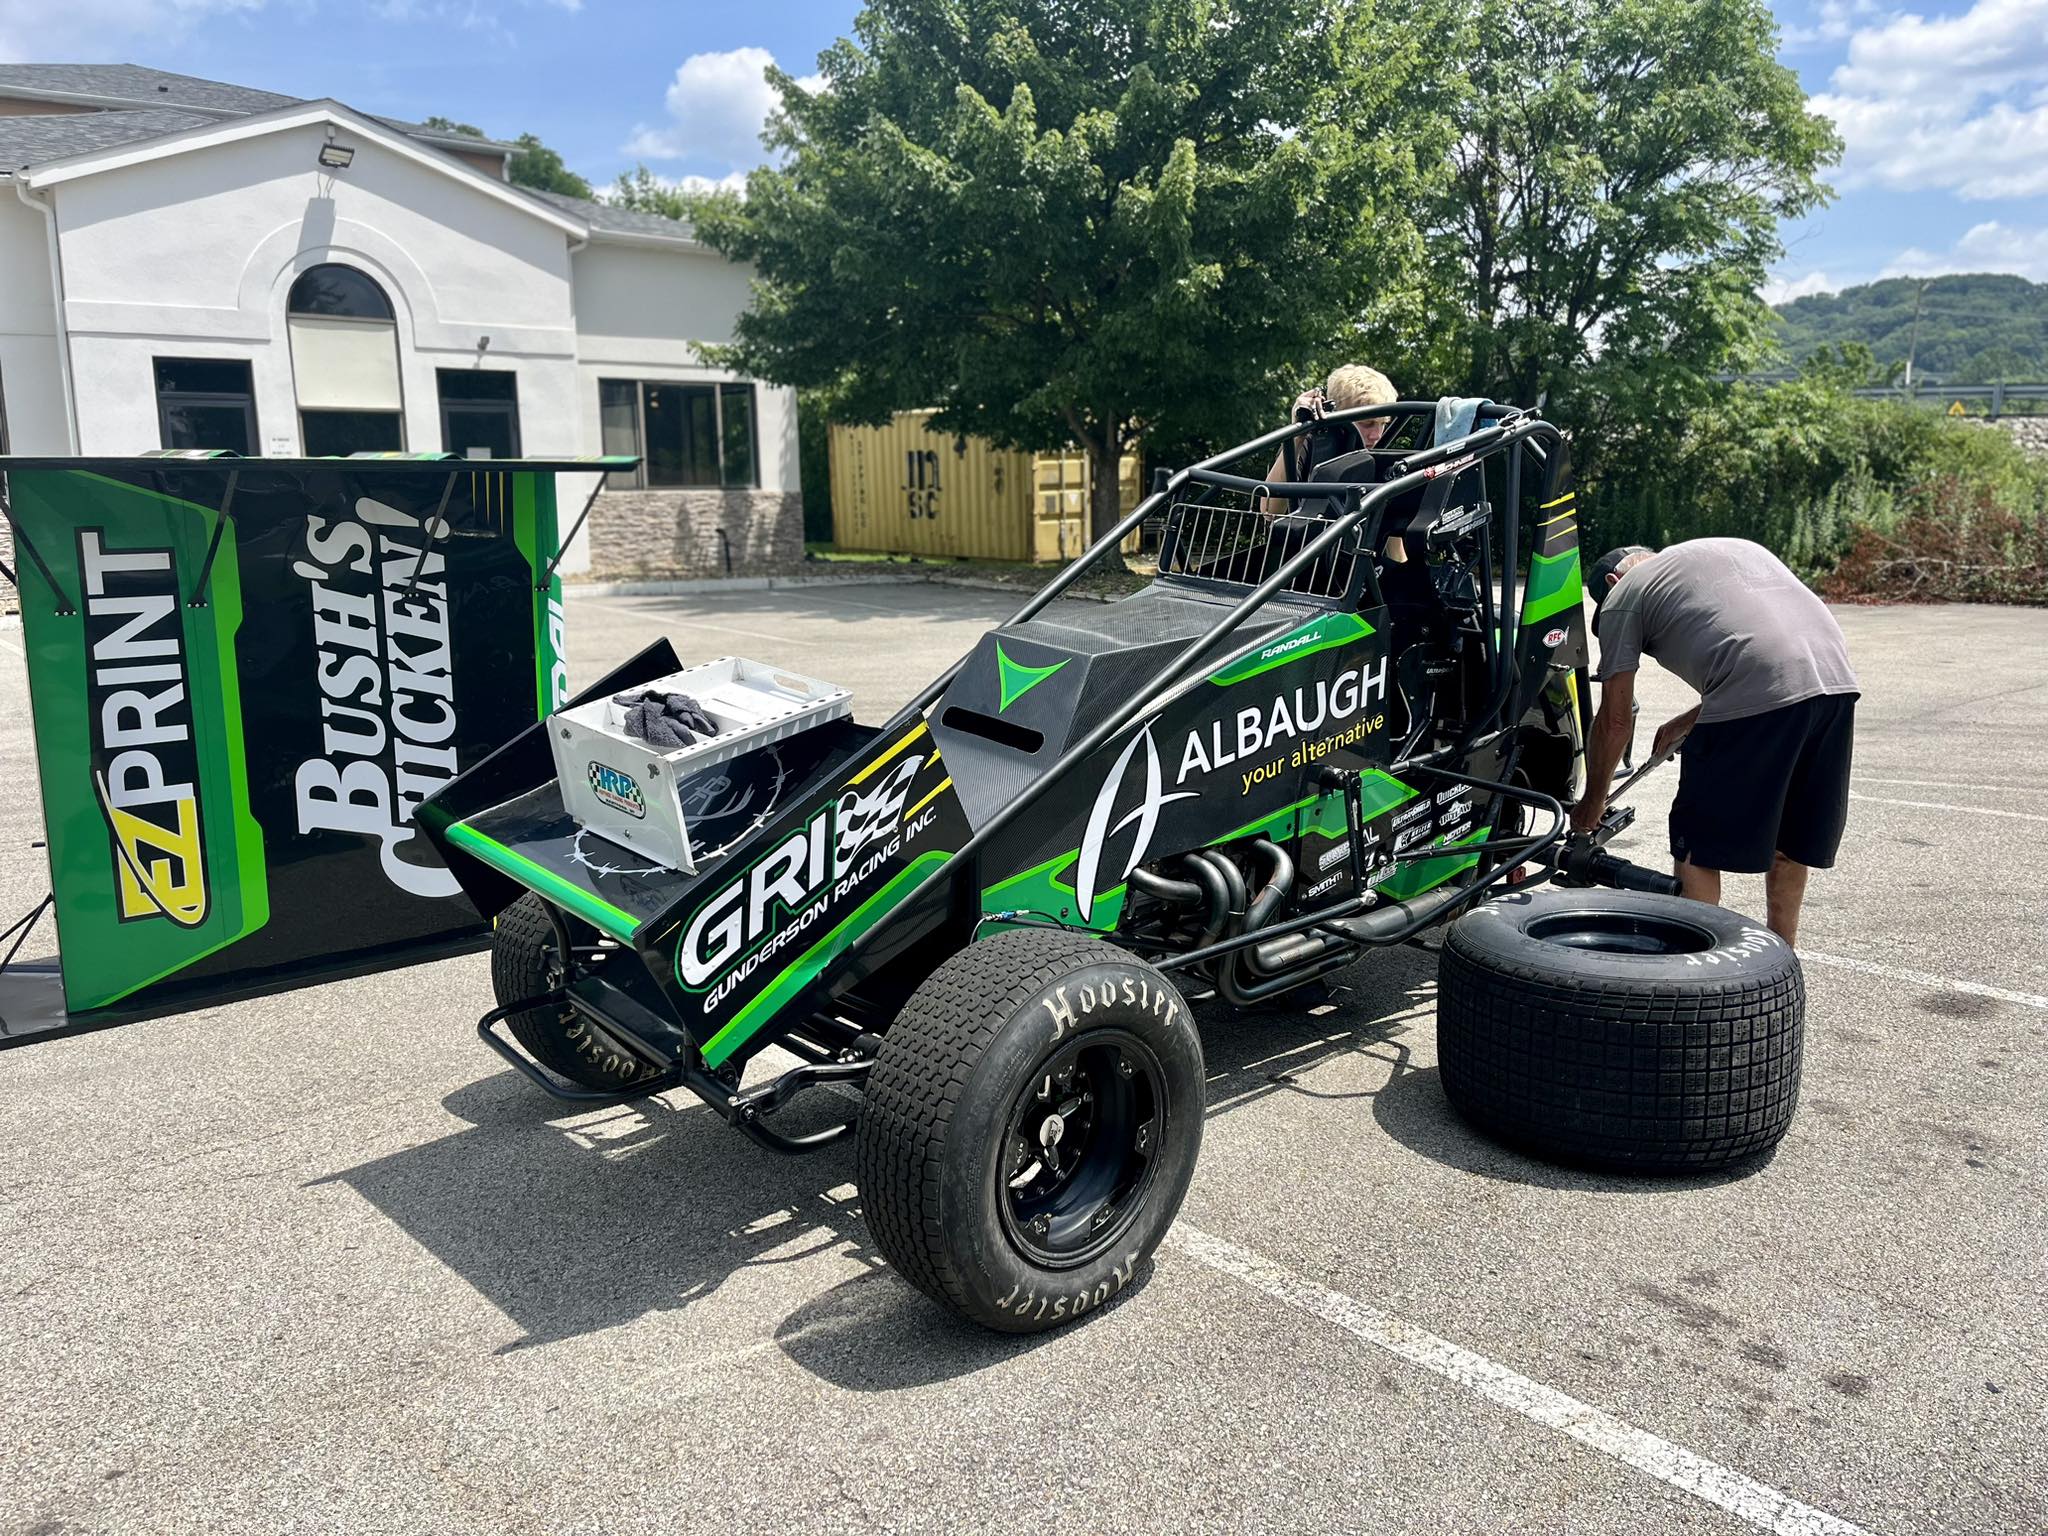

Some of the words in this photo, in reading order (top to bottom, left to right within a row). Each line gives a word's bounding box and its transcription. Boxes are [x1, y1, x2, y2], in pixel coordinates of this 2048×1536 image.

[295, 514, 390, 835] BUSH'S
[1260, 631, 1322, 660] RANDALL
[1176, 656, 1388, 785] ALBAUGH
[1241, 757, 1285, 795] your
[1291, 713, 1385, 767] alternative
[600, 766, 632, 798] HRP
[680, 812, 827, 986] GRI
[703, 895, 829, 1014] GUNDERSON
[833, 834, 901, 903] RACING
[905, 806, 937, 843] INC.
[1042, 970, 1180, 1042] Hoosier
